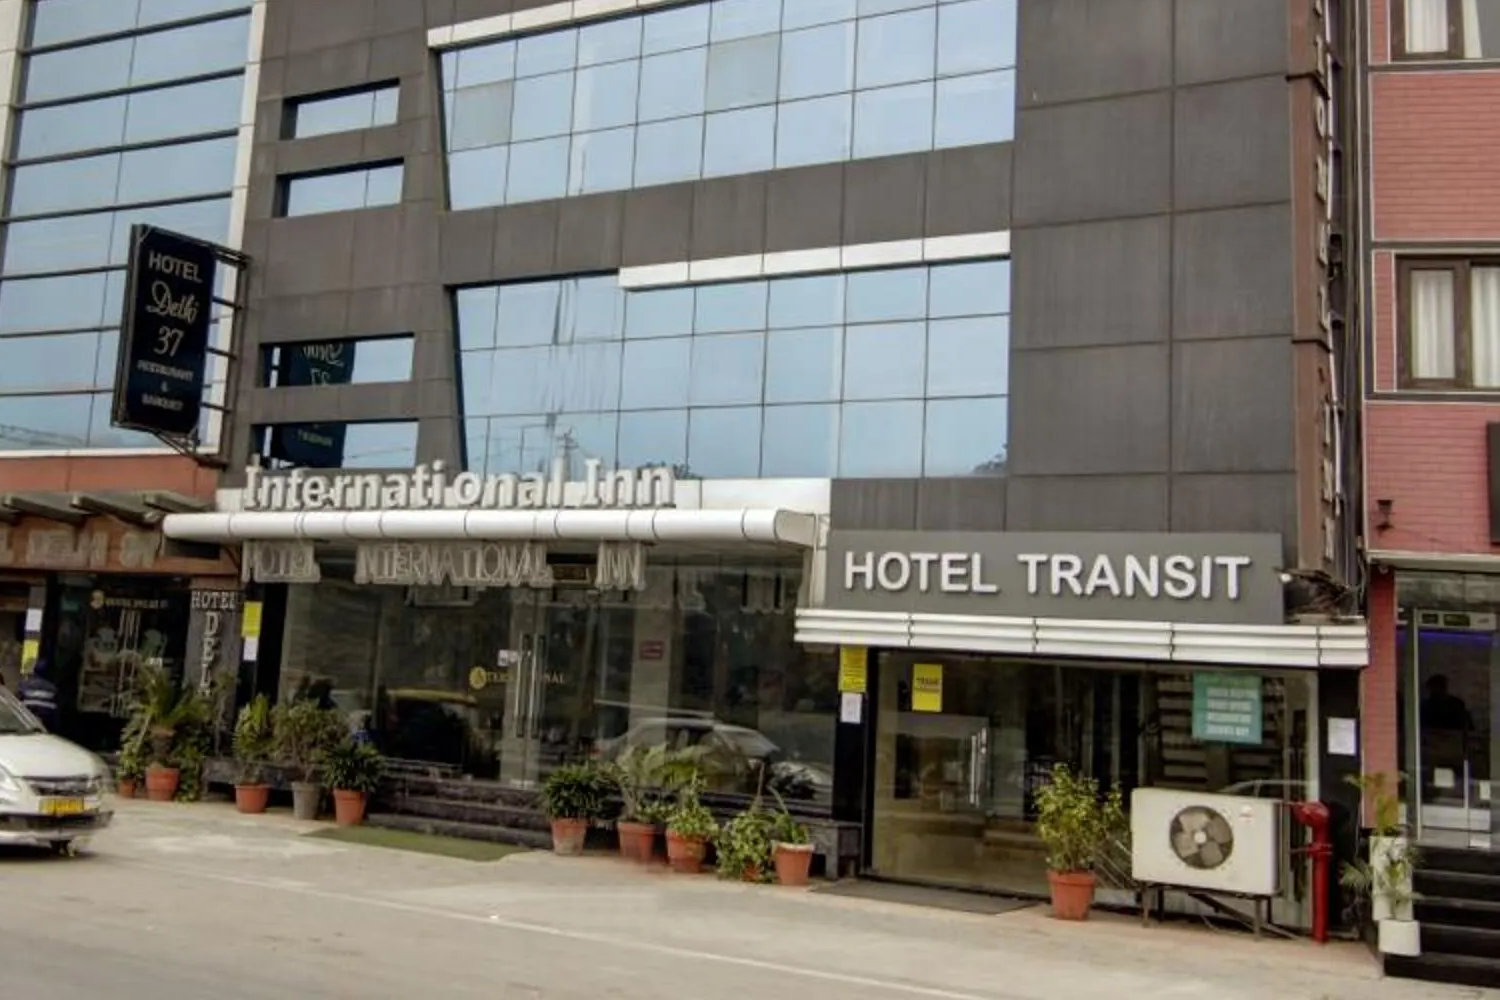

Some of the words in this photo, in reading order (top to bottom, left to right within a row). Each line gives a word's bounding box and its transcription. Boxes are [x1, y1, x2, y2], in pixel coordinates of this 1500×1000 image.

[148, 251, 204, 284] HOTEL
[145, 280, 200, 325] Delhi
[153, 325, 185, 357] 37
[245, 459, 563, 508] International
[583, 458, 677, 508] Inn
[843, 551, 998, 593] HOTEL
[1017, 553, 1251, 599] TRANSIT
[190, 590, 238, 609] HOTEL
